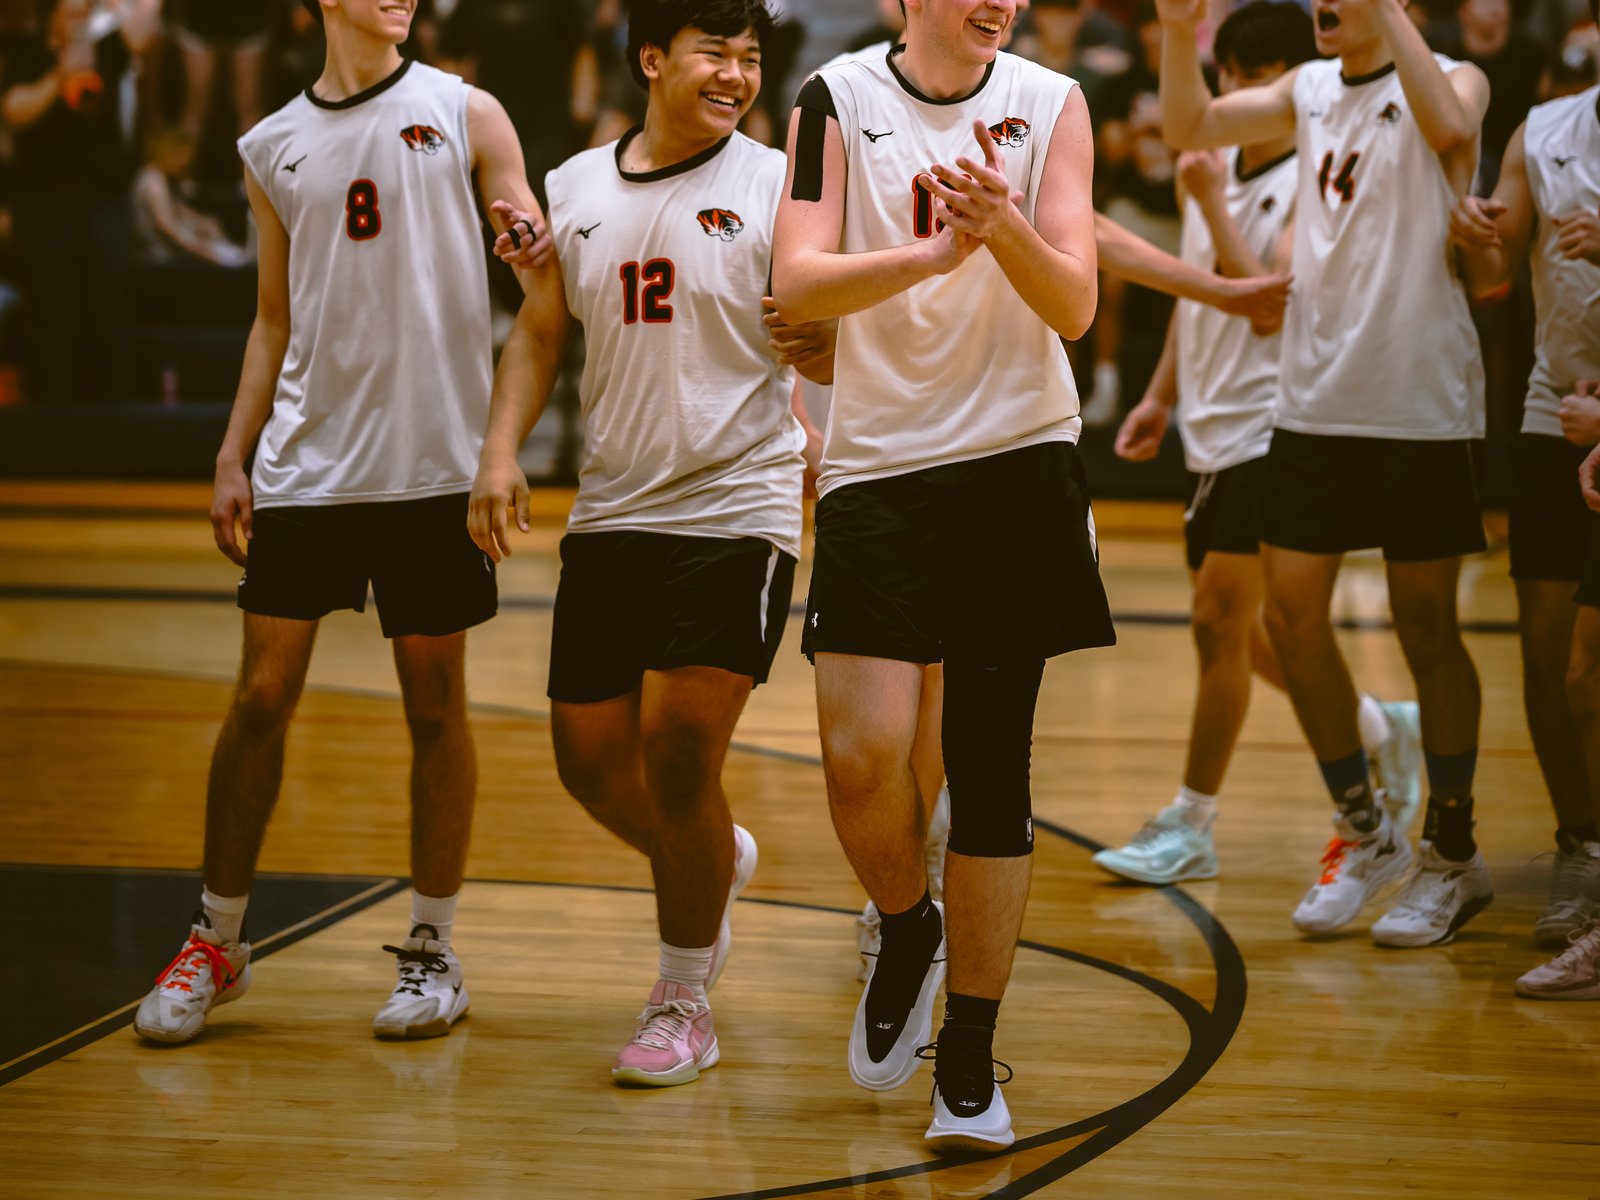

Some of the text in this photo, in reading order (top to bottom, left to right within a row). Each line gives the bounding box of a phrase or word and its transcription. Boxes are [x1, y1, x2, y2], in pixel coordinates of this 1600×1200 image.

[1318, 149, 1360, 202] 14
[345, 178, 382, 241] 8
[619, 257, 675, 325] 12
